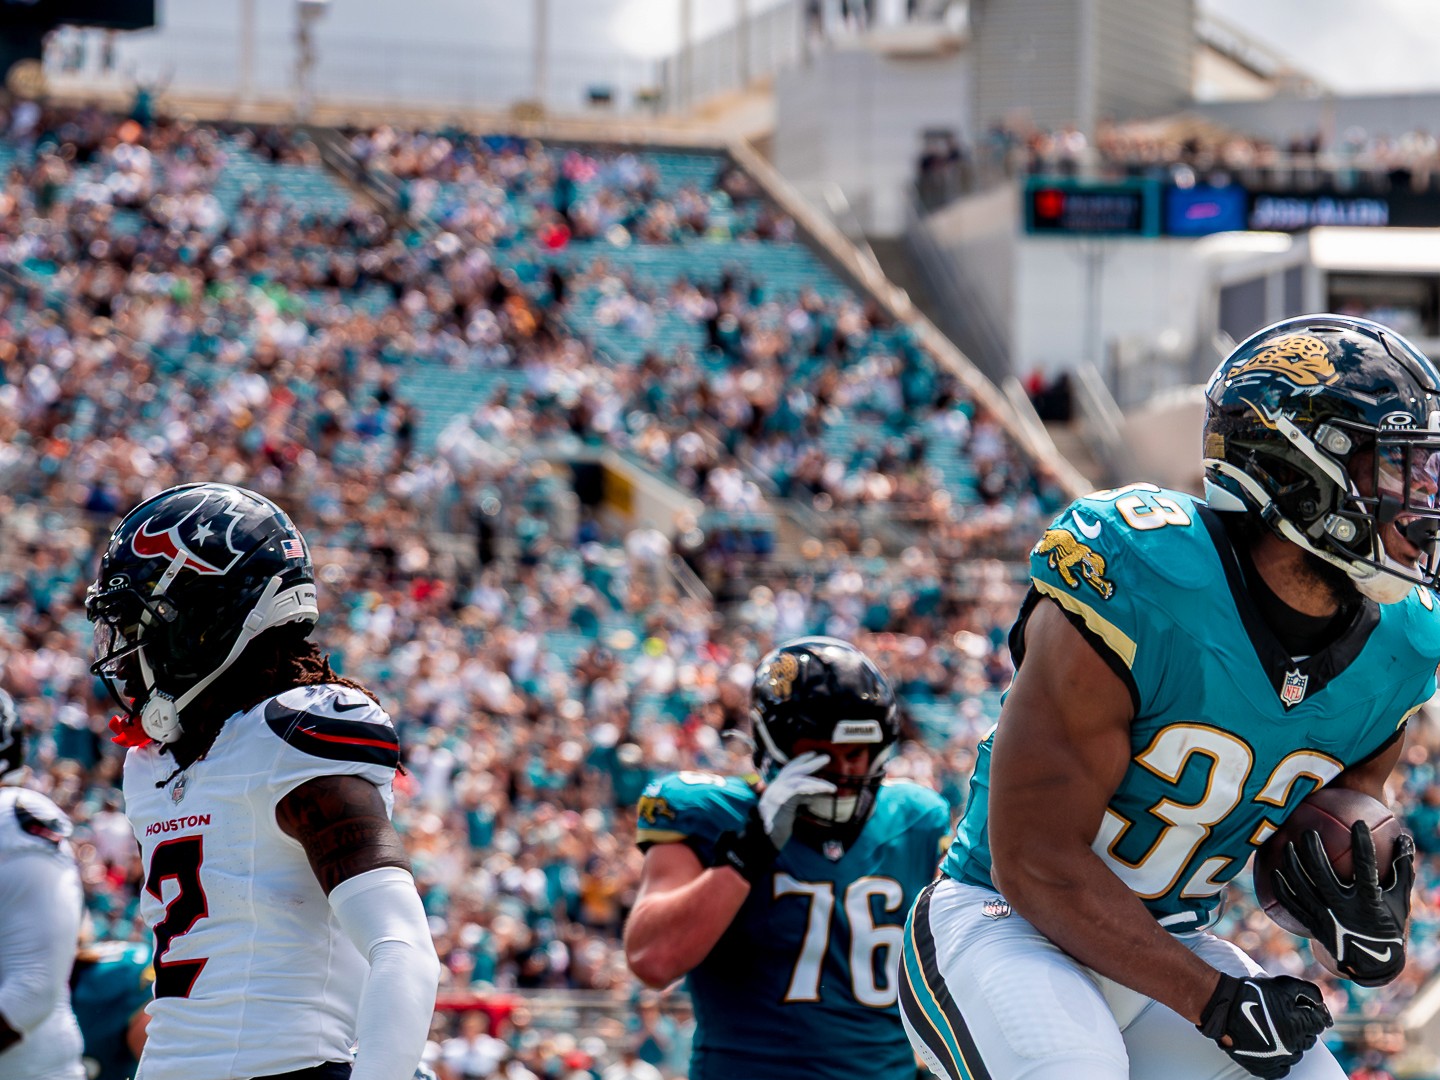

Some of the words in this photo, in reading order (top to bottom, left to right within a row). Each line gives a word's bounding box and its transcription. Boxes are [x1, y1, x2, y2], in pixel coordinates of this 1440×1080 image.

[1285, 684, 1302, 699] NFL
[146, 813, 212, 837] HOUSTON
[145, 834, 209, 999] 2
[772, 873, 905, 1008] 76
